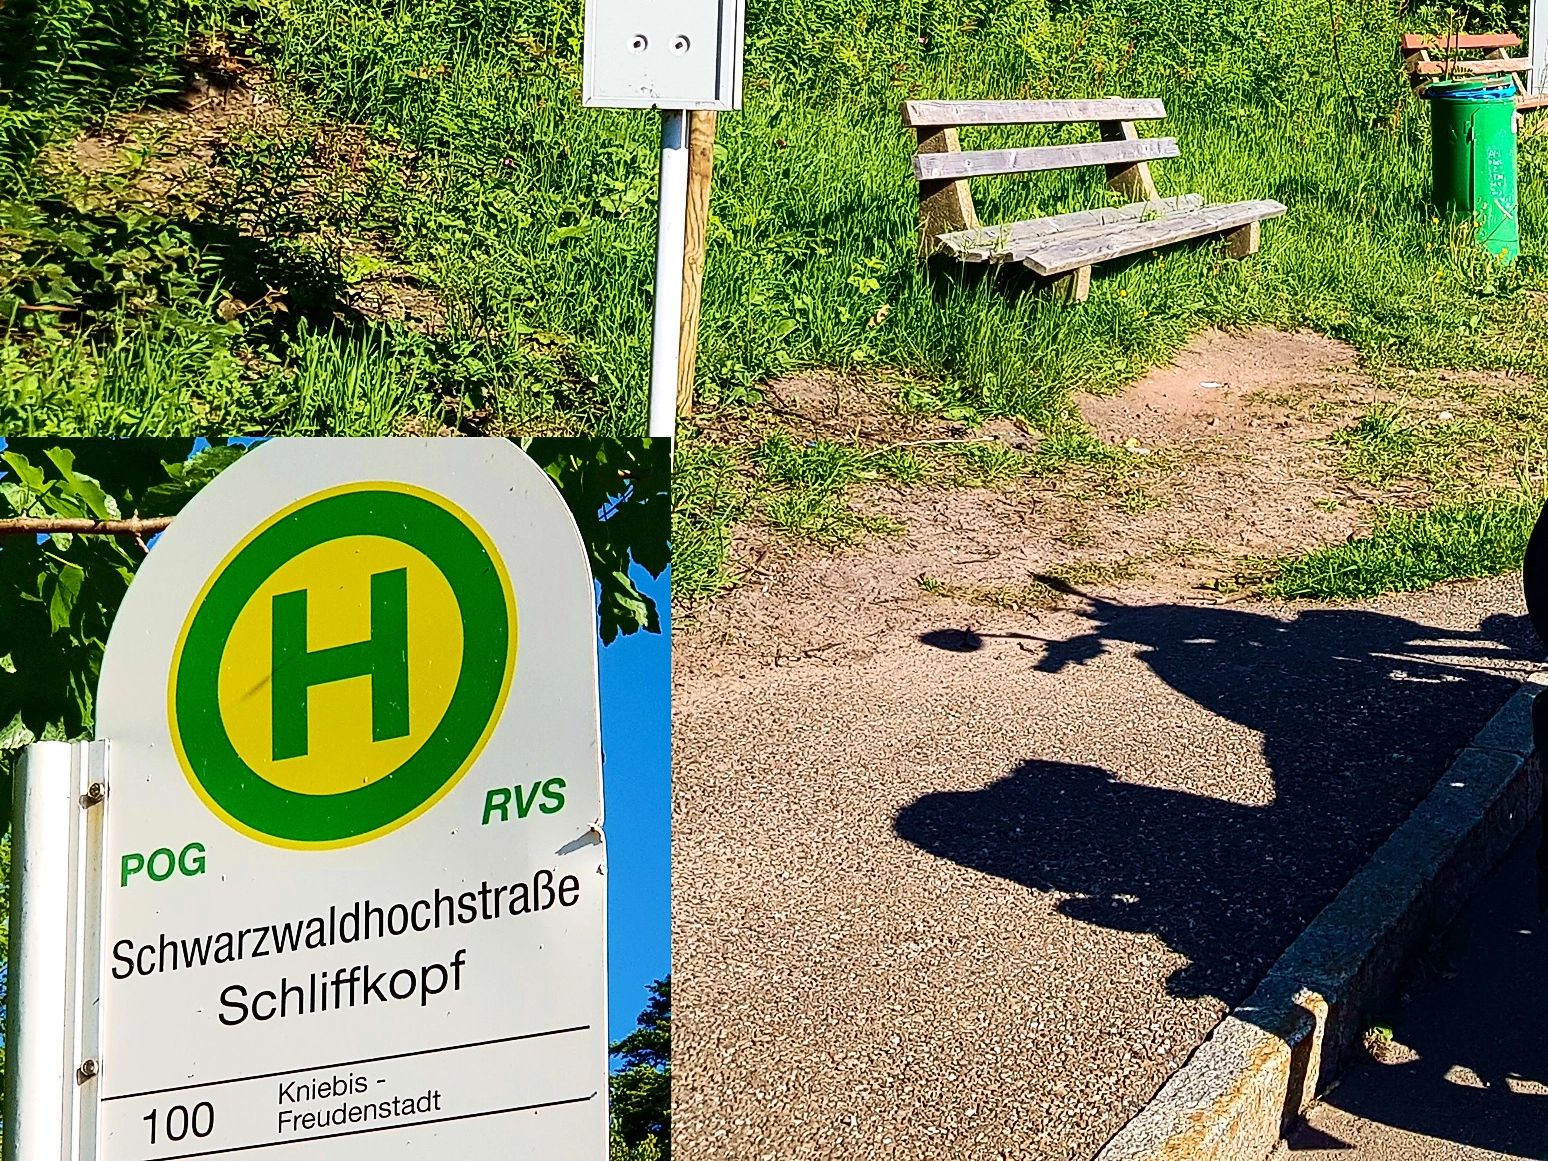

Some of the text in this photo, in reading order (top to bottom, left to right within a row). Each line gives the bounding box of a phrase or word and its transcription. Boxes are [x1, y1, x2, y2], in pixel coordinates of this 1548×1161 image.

[271, 566, 411, 763] H
[481, 776, 567, 826] RVS
[119, 841, 207, 888] POG
[111, 868, 581, 981] Schwarzwaldhochstraße
[217, 950, 467, 1027] Schliffkopf
[277, 1071, 370, 1106] Kniebis
[277, 1089, 442, 1134] Freudenstadt
[142, 1100, 216, 1145] 100
